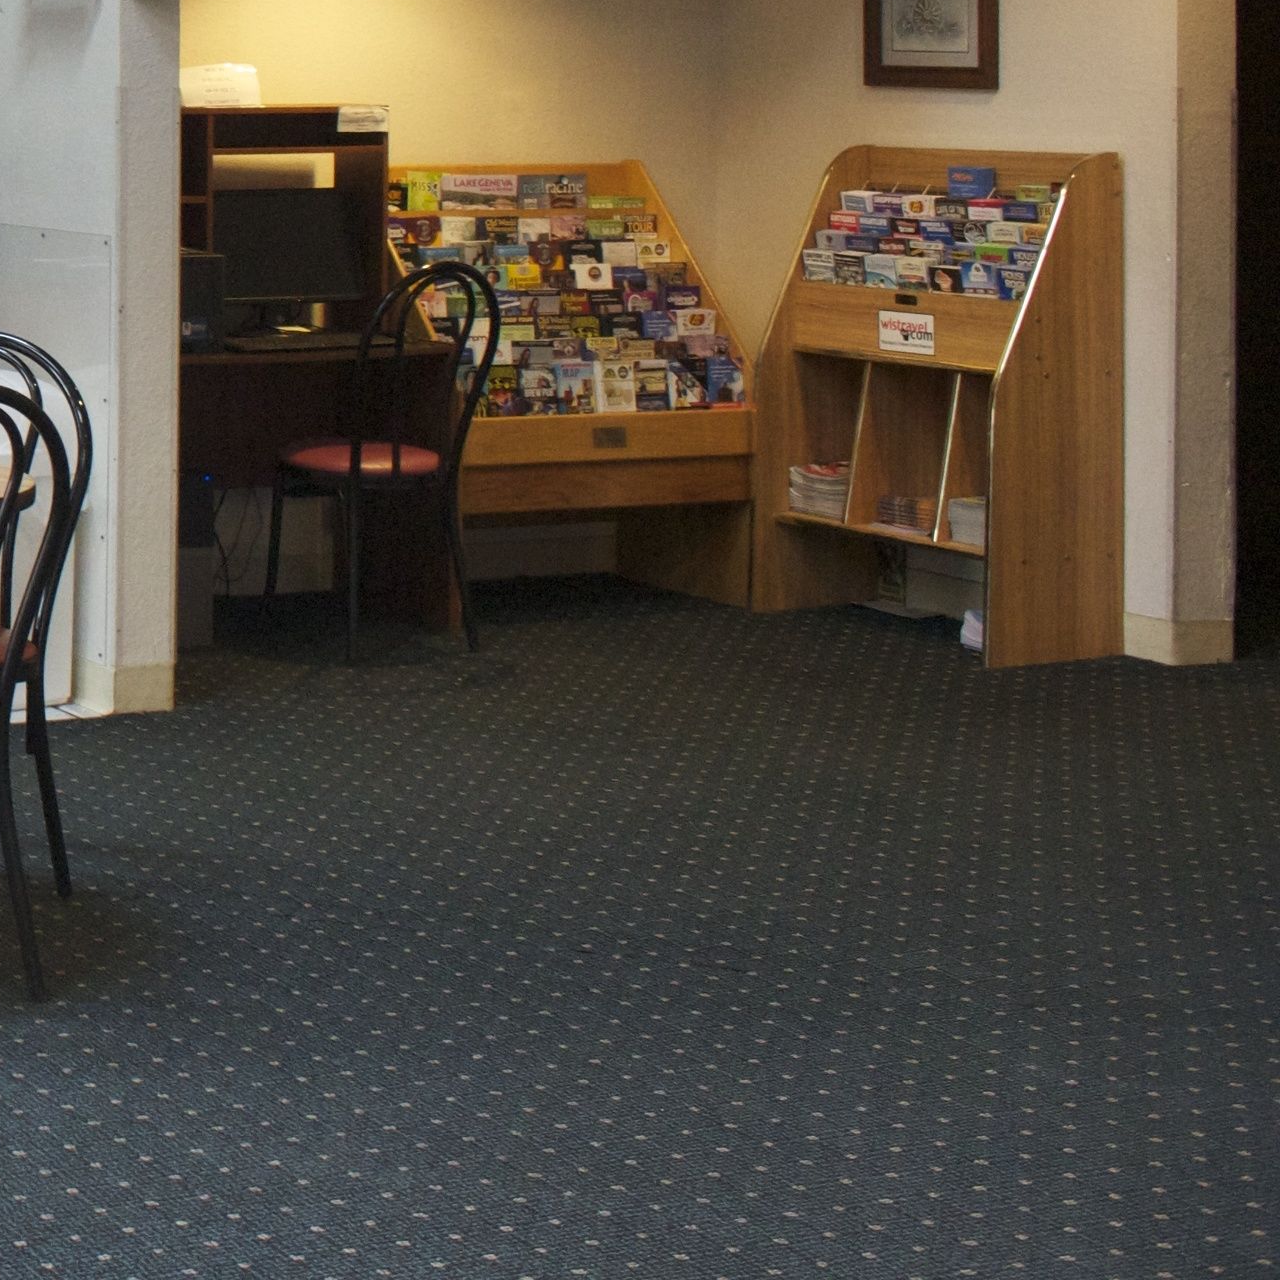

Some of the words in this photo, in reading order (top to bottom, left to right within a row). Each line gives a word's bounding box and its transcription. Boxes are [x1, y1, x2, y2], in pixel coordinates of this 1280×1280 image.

[454, 178, 477, 187] LAKE
[478, 178, 513, 188] GENEVA
[626, 222, 654, 232] TOUR
